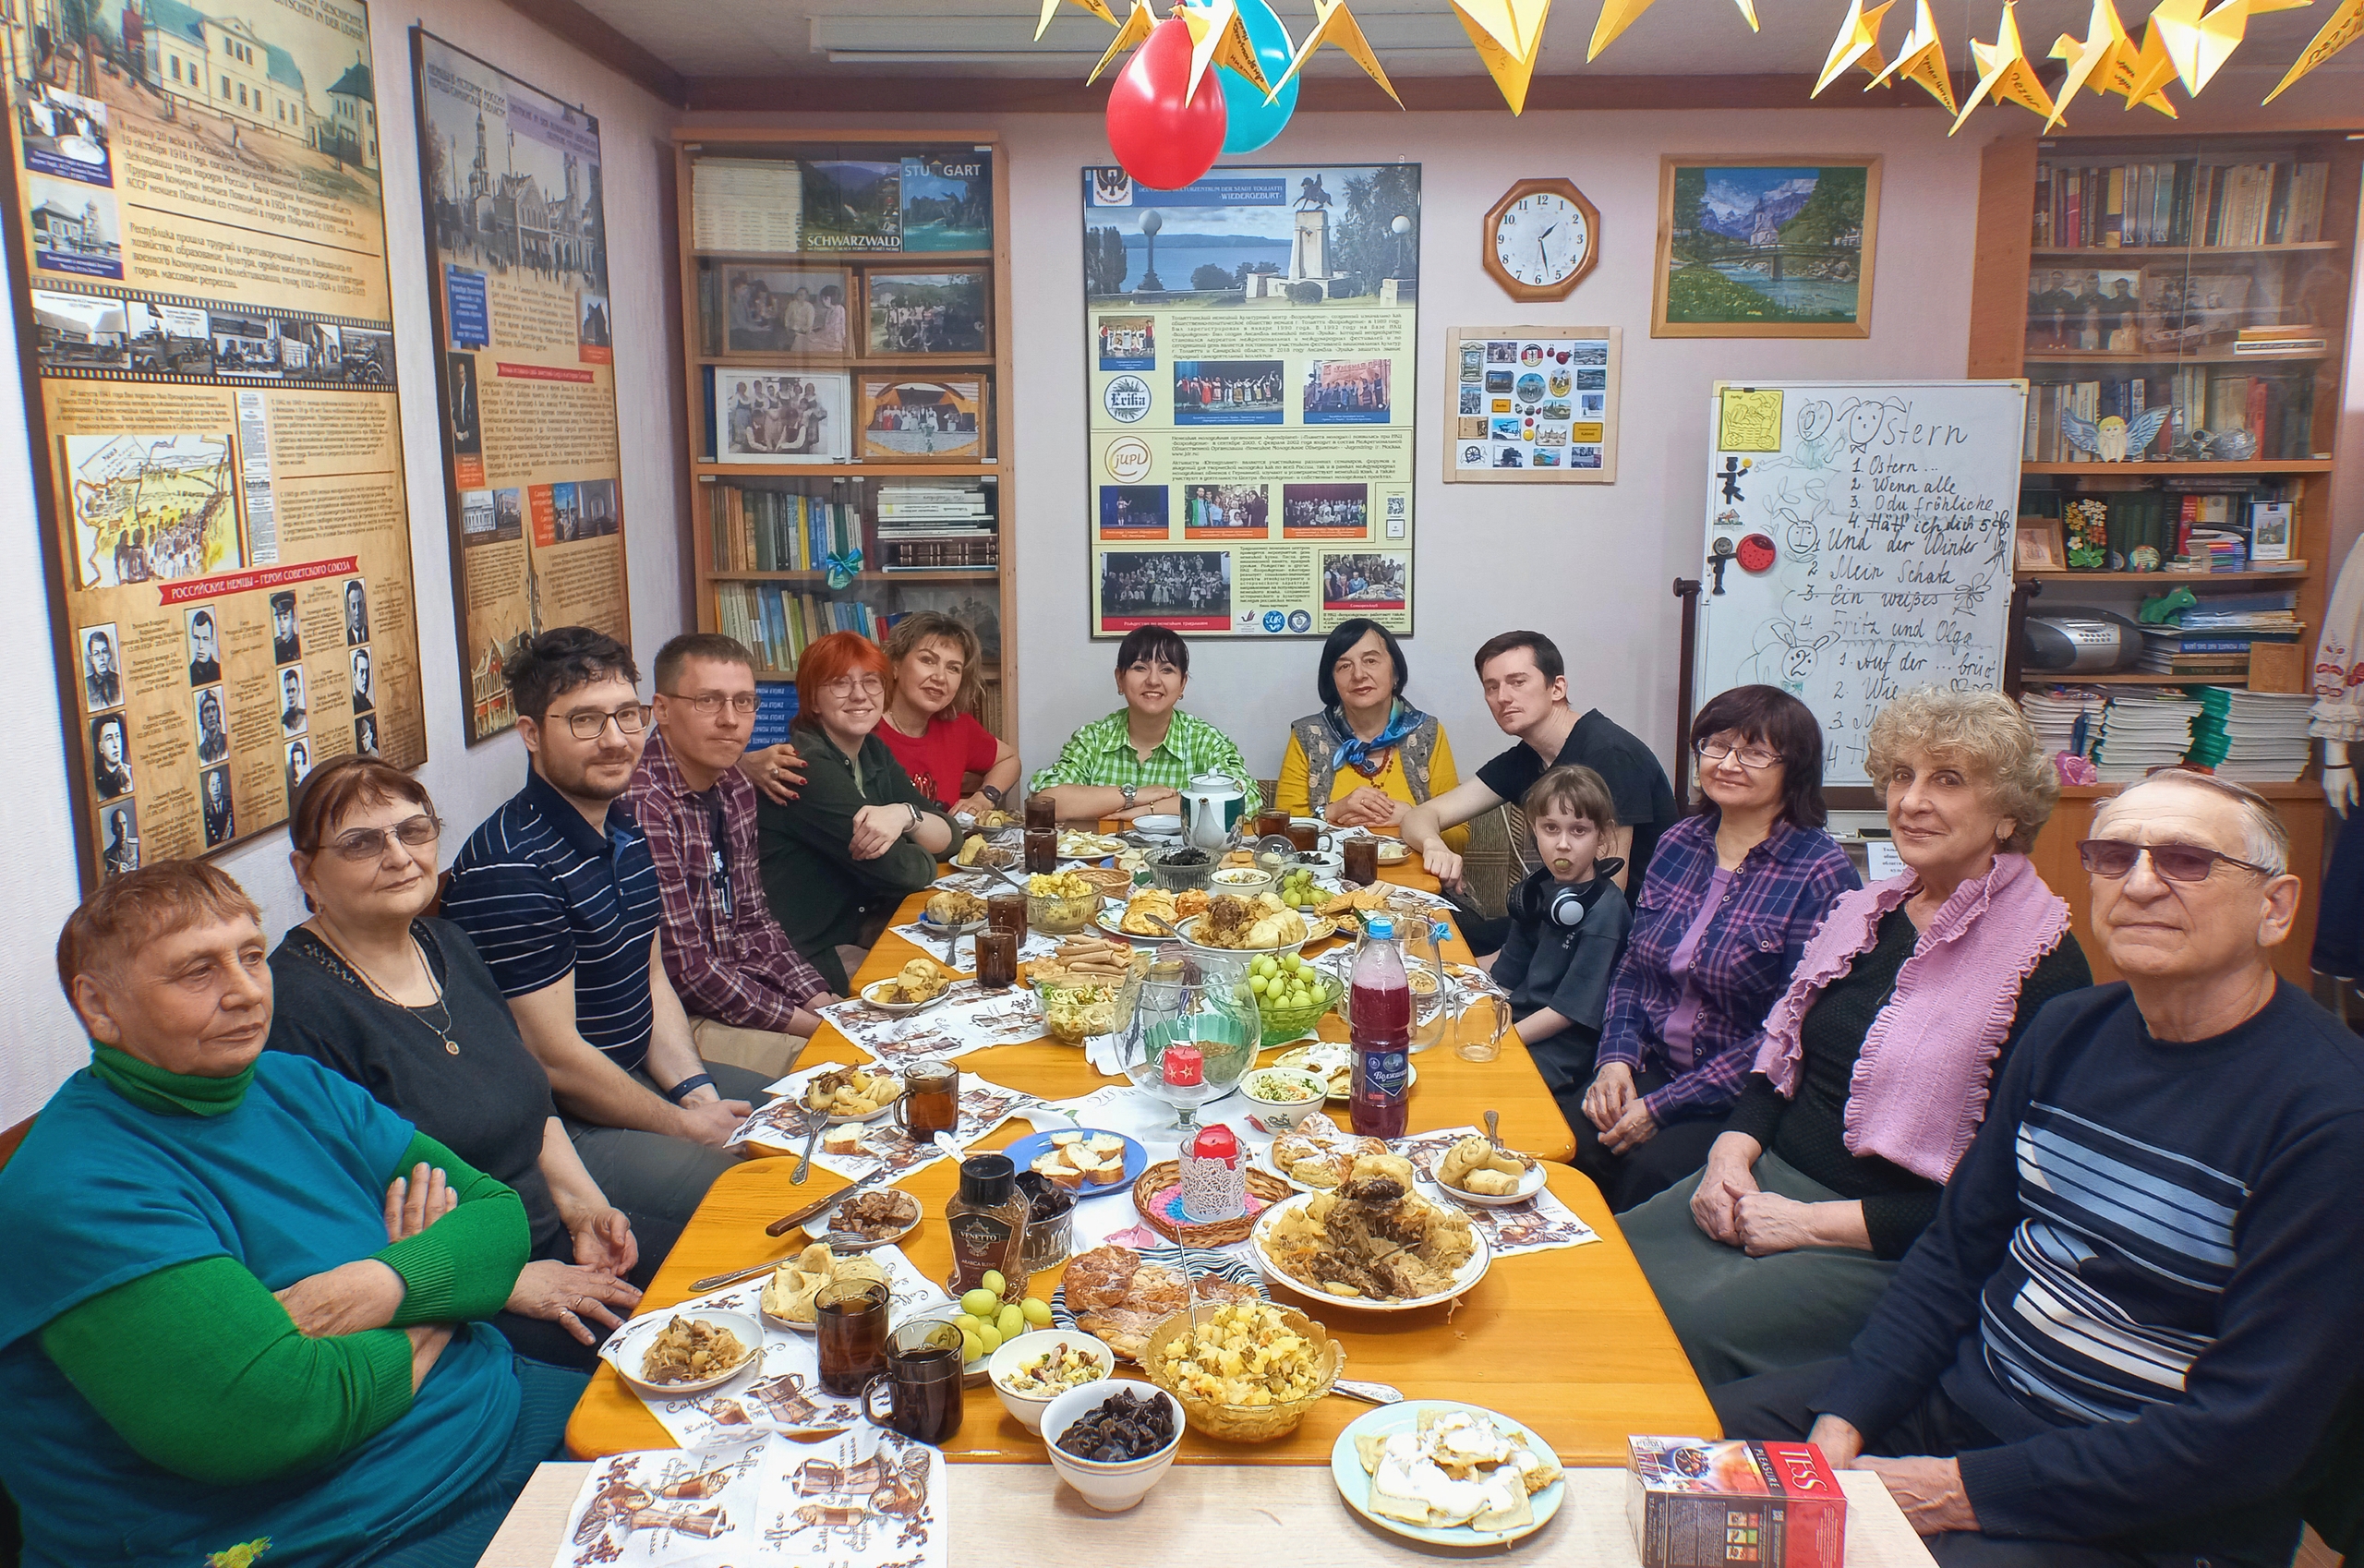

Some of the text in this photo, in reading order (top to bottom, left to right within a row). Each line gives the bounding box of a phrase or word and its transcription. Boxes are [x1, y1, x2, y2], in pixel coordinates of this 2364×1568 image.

[1518, 200, 1528, 211] 11
[1537, 195, 1549, 205] 12
[1560, 200, 1564, 211] 1
[1503, 214, 1515, 224] 10
[1573, 214, 1579, 224] 2
[807, 235, 900, 247] SCHWARZWALD
[1498, 235, 1505, 244] 9
[1577, 235, 1584, 244] 3
[1502, 254, 1509, 264] 8
[1570, 255, 1576, 264] 4
[1515, 270, 1522, 280] 7
[1535, 275, 1542, 284] 6
[1555, 270, 1562, 280] 5
[1852, 458, 1863, 473] 1.
[1869, 453, 1918, 476] Ostern
[1851, 476, 1956, 495] 2. Wenn alle
[1850, 495, 1861, 509] 3.
[1914, 494, 1994, 517] fröhliche
[1914, 519, 1939, 535] ich
[1828, 527, 1872, 551] Und
[1887, 530, 1914, 553] der
[1924, 531, 1979, 555] Winter
[1830, 555, 1885, 580] Mein
[1898, 559, 1955, 585] Schatz
[171, 561, 351, 599] РОССИЙСКИЕ НЕМЦЫ ГЕРОИ СОВЕТСКОГО СОЮЗА
[1831, 585, 1864, 606] Ein
[1881, 590, 1938, 612] weißes
[1892, 619, 1924, 638] und
[1936, 620, 1972, 654] Olga
[1857, 644, 1896, 677] Auf
[1900, 651, 1928, 671] der
[960, 1231, 996, 1241] VENETTO
[1755, 1448, 1780, 1489] PLEASURE
[1779, 1448, 1828, 1491] TESS
